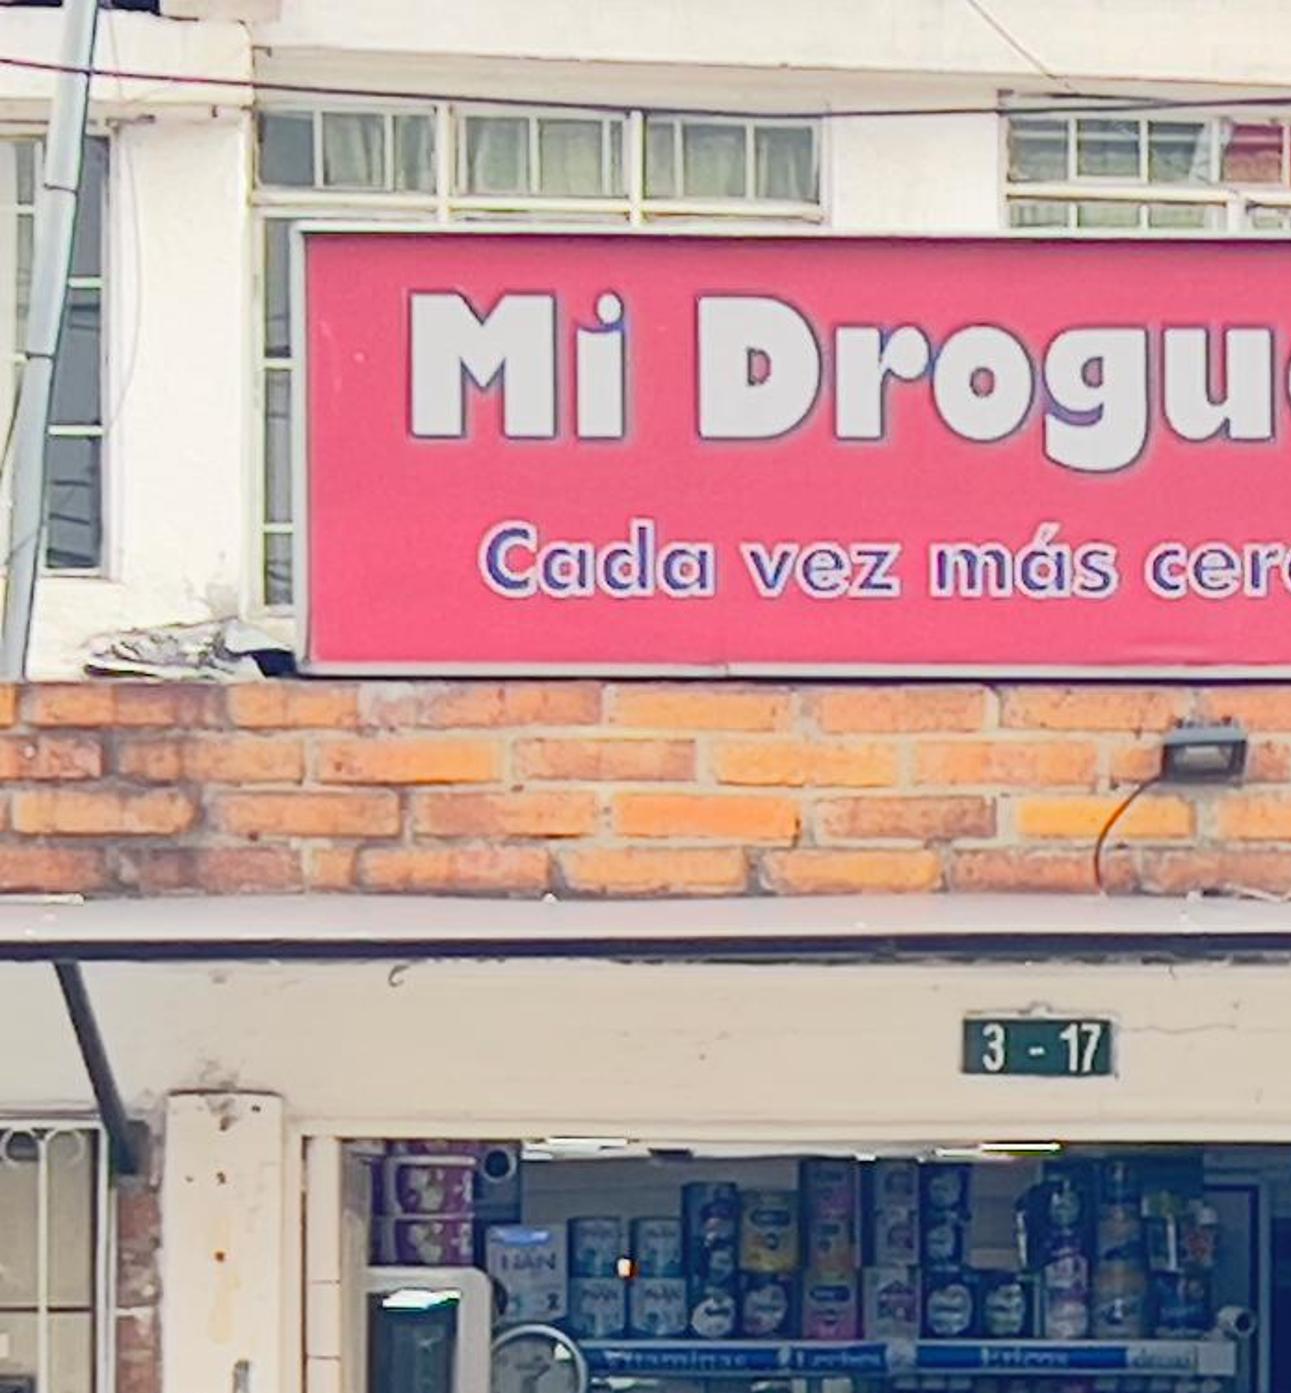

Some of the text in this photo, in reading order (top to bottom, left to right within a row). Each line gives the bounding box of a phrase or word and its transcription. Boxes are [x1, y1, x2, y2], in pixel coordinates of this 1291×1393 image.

[410, 293, 625, 439] Mi
[478, 518, 715, 599] Cada
[739, 541, 903, 600] vez
[929, 521, 1120, 600] más
